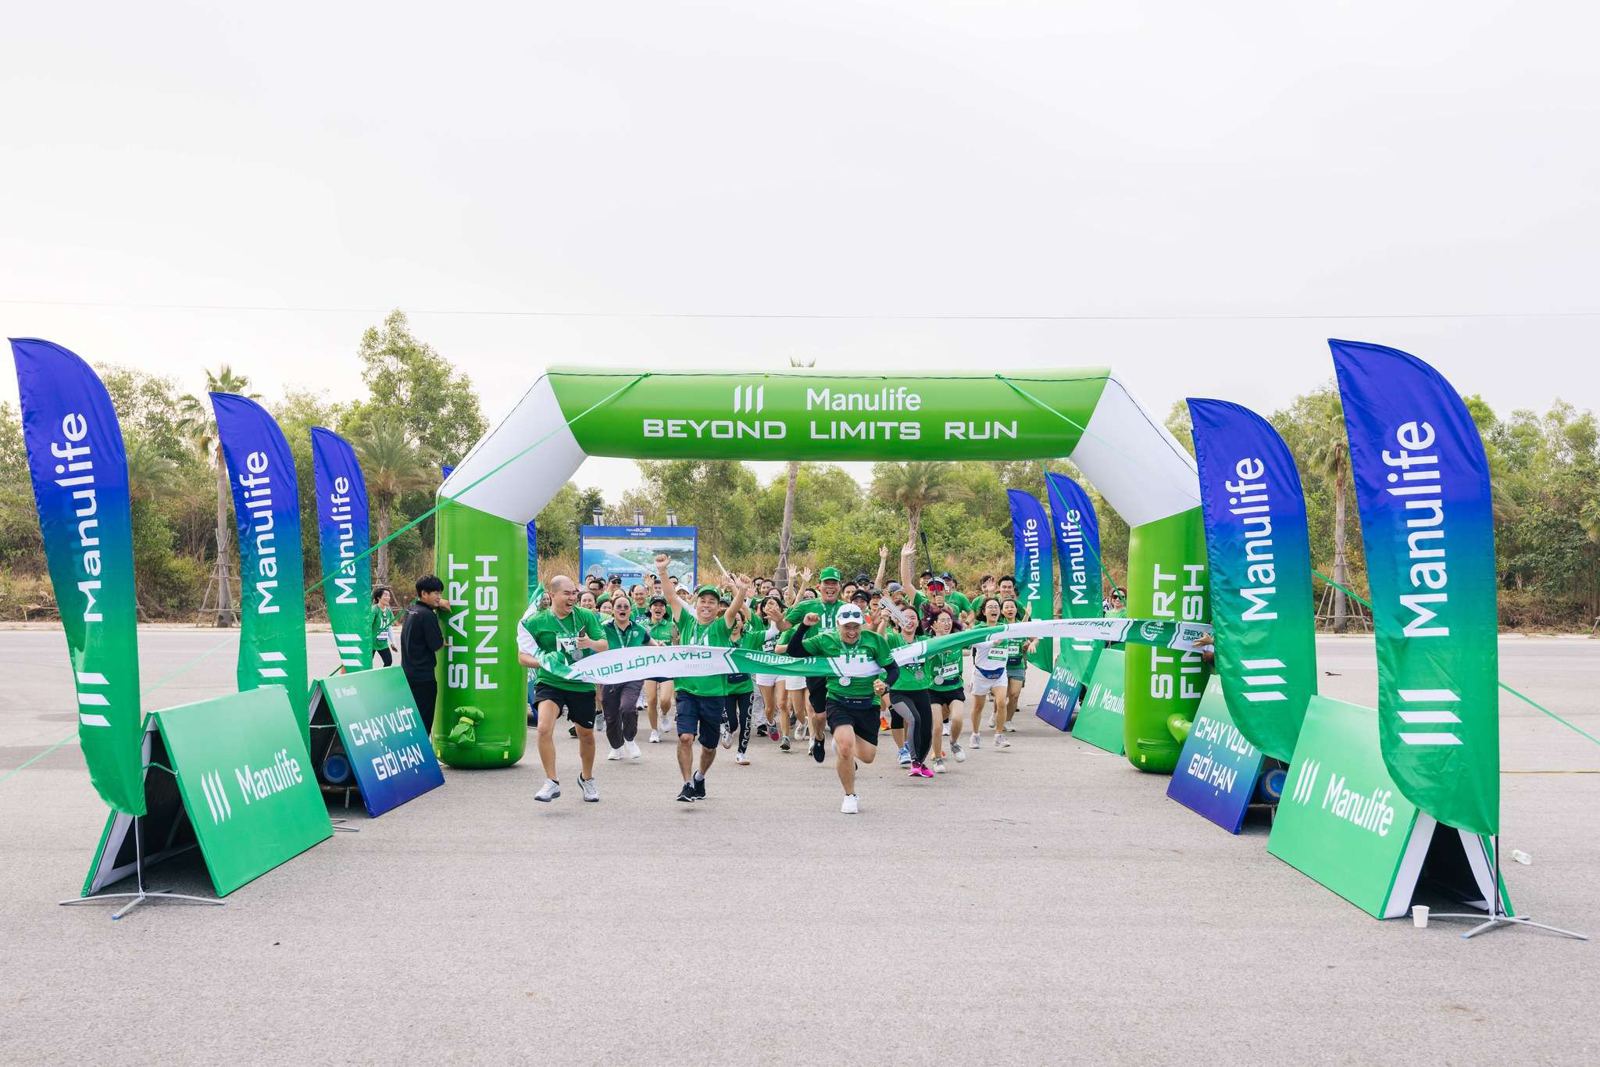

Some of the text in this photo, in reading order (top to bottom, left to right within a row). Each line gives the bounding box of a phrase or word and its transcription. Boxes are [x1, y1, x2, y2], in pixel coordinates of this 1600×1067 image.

[643, 419, 1018, 441] BEYOND LIMITS RUN
[806, 387, 922, 412] Manulife
[51, 412, 104, 622] Manulife
[239, 451, 280, 614] Manulife
[329, 476, 358, 604] Manulife
[1022, 518, 1041, 600] Manulife
[1060, 509, 1089, 605] Manulife
[1225, 457, 1278, 621] Manulife
[1381, 420, 1450, 638] Manulife
[448, 553, 470, 689] START
[474, 555, 499, 690] FINISH
[1150, 563, 1177, 700] STRT
[349, 705, 417, 747] CHẠY VƯỢT
[371, 743, 425, 782] GIỚI HẠN
[1194, 716, 1229, 750] CHẠY
[234, 748, 304, 806] Manulife
[1187, 750, 1238, 797] GIỚI HẠN
[1321, 773, 1395, 837] Manulife
